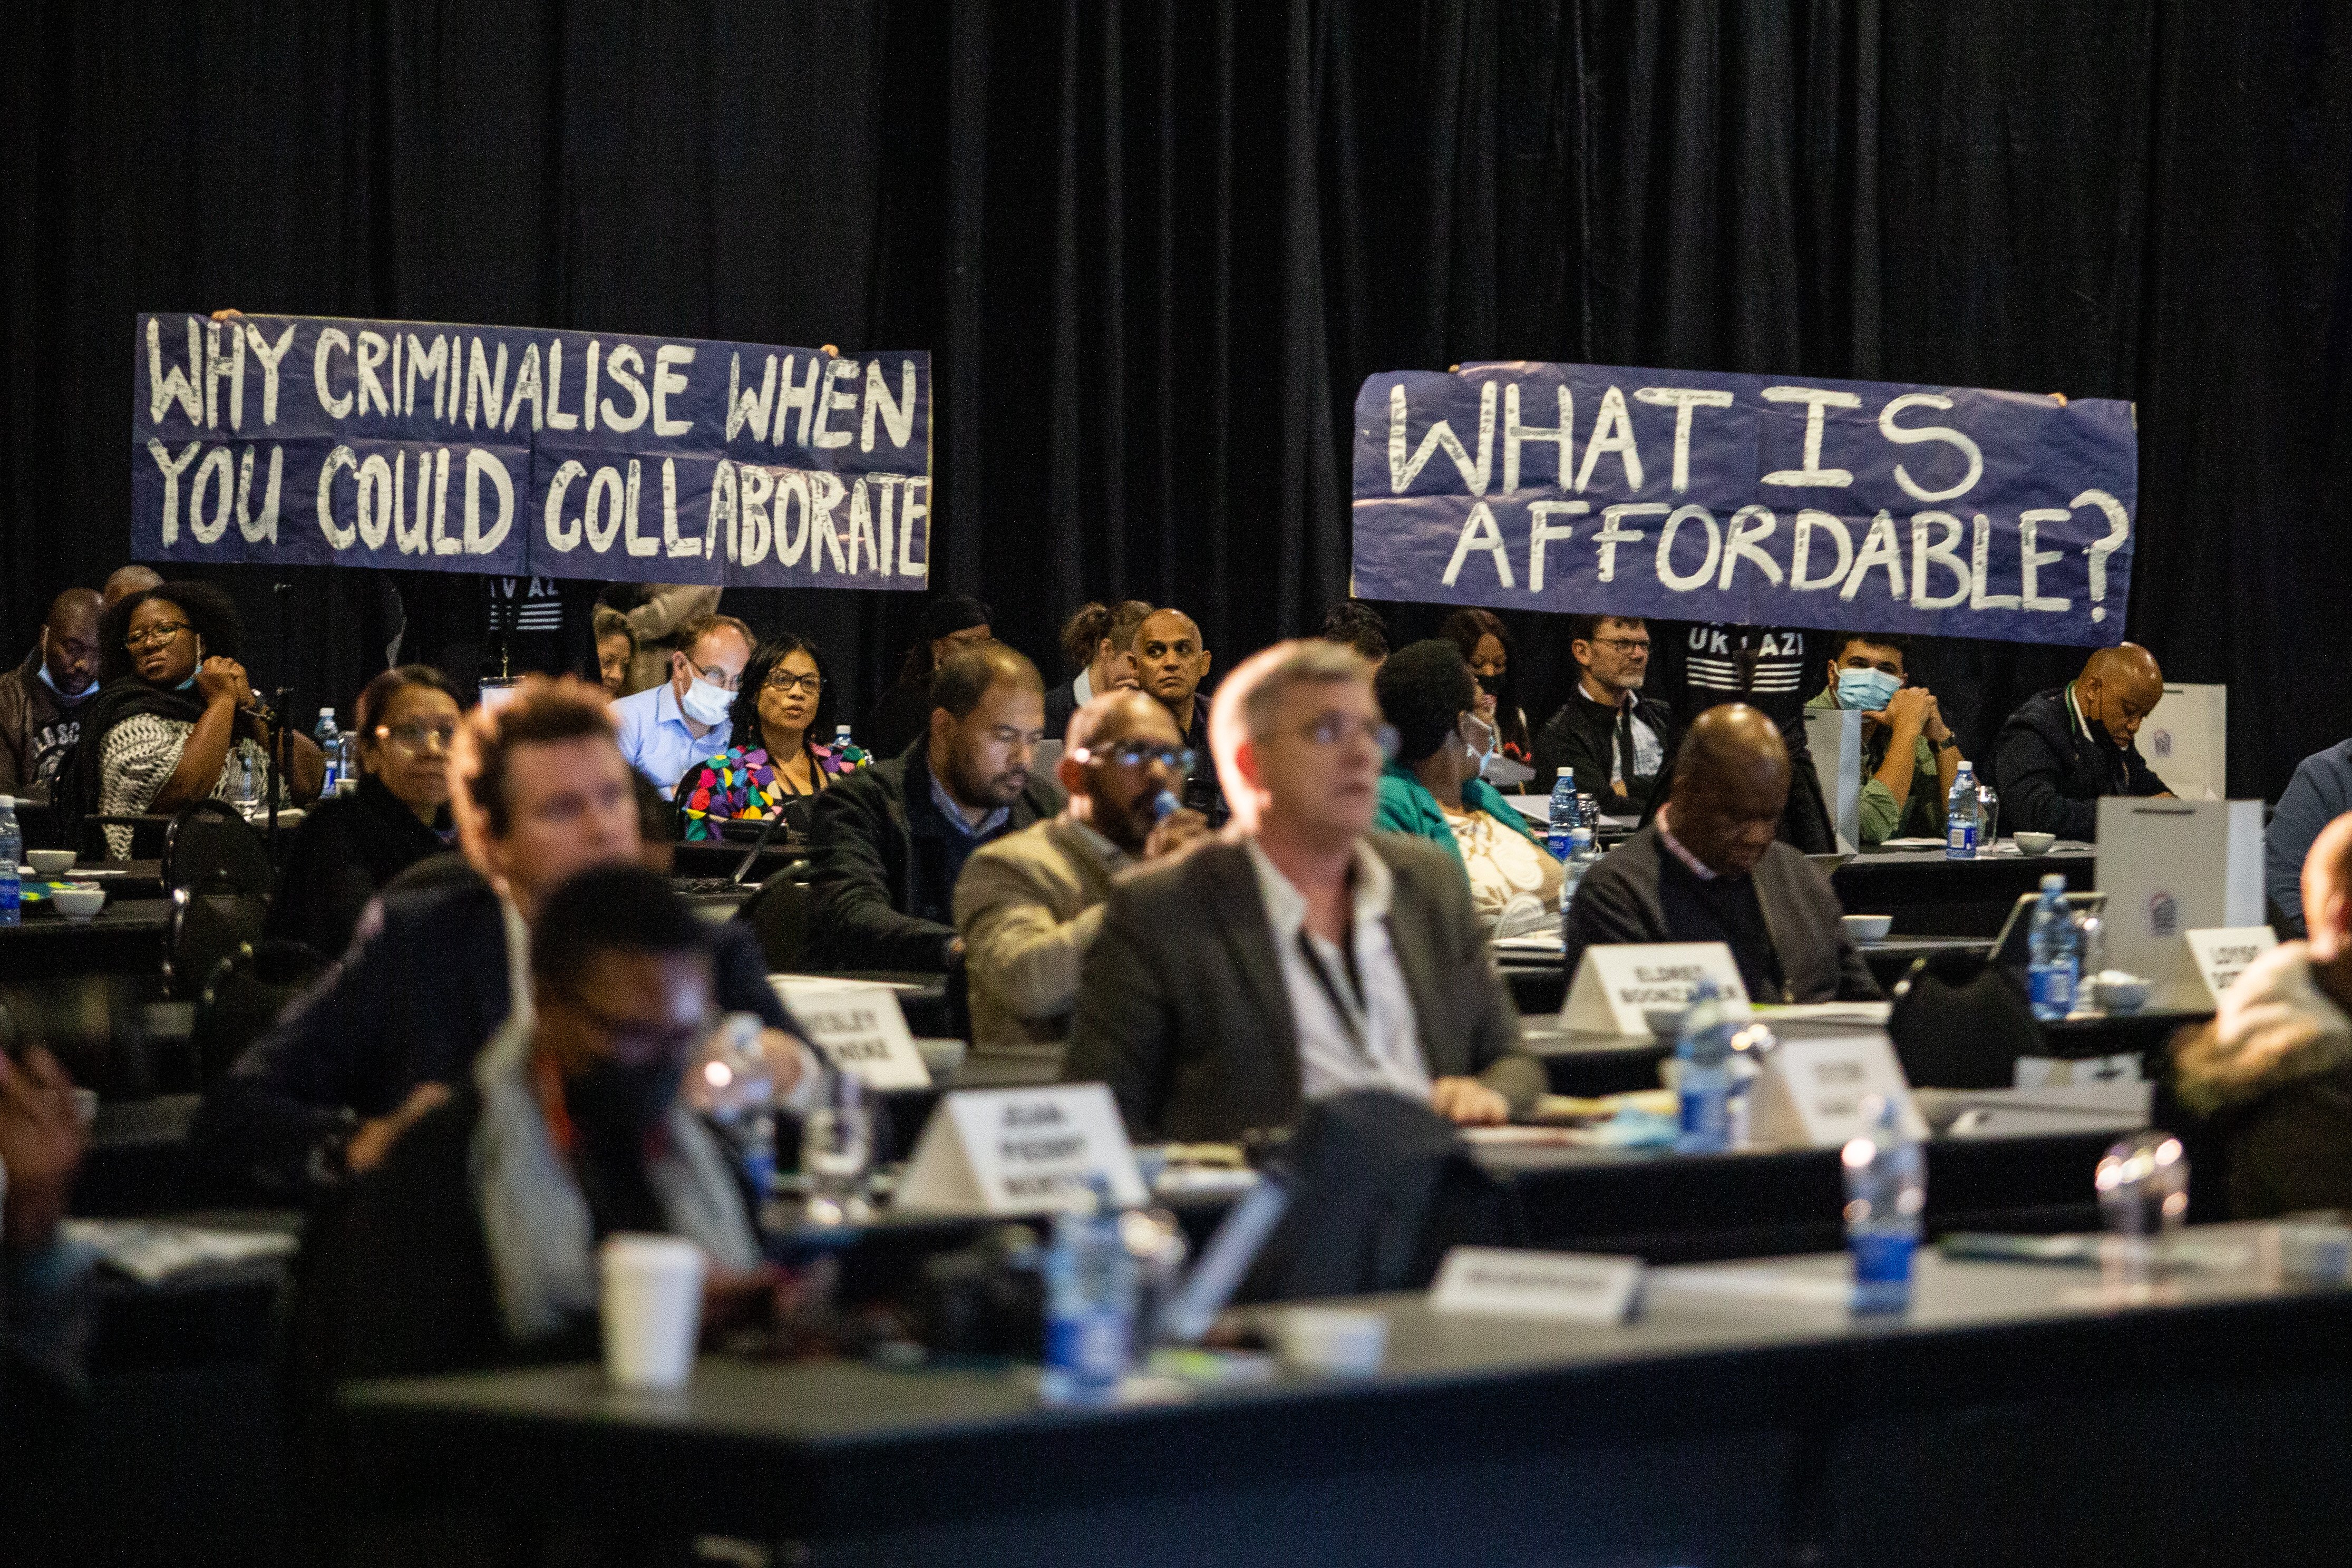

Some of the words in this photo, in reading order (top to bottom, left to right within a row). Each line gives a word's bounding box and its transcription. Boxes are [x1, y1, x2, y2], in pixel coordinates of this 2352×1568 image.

[147, 316, 297, 431] WHY
[314, 327, 696, 436] CRIMINALISE
[726, 352, 917, 452] WHEN
[1388, 380, 1734, 496] WHAT
[1761, 386, 1983, 502] IS
[148, 437, 284, 548] YOU
[317, 445, 515, 556] COULD
[545, 457, 931, 577] COLLABORATE
[1442, 489, 2130, 624] AFFORDABLE?
[1688, 627, 1804, 657] UKAZI
